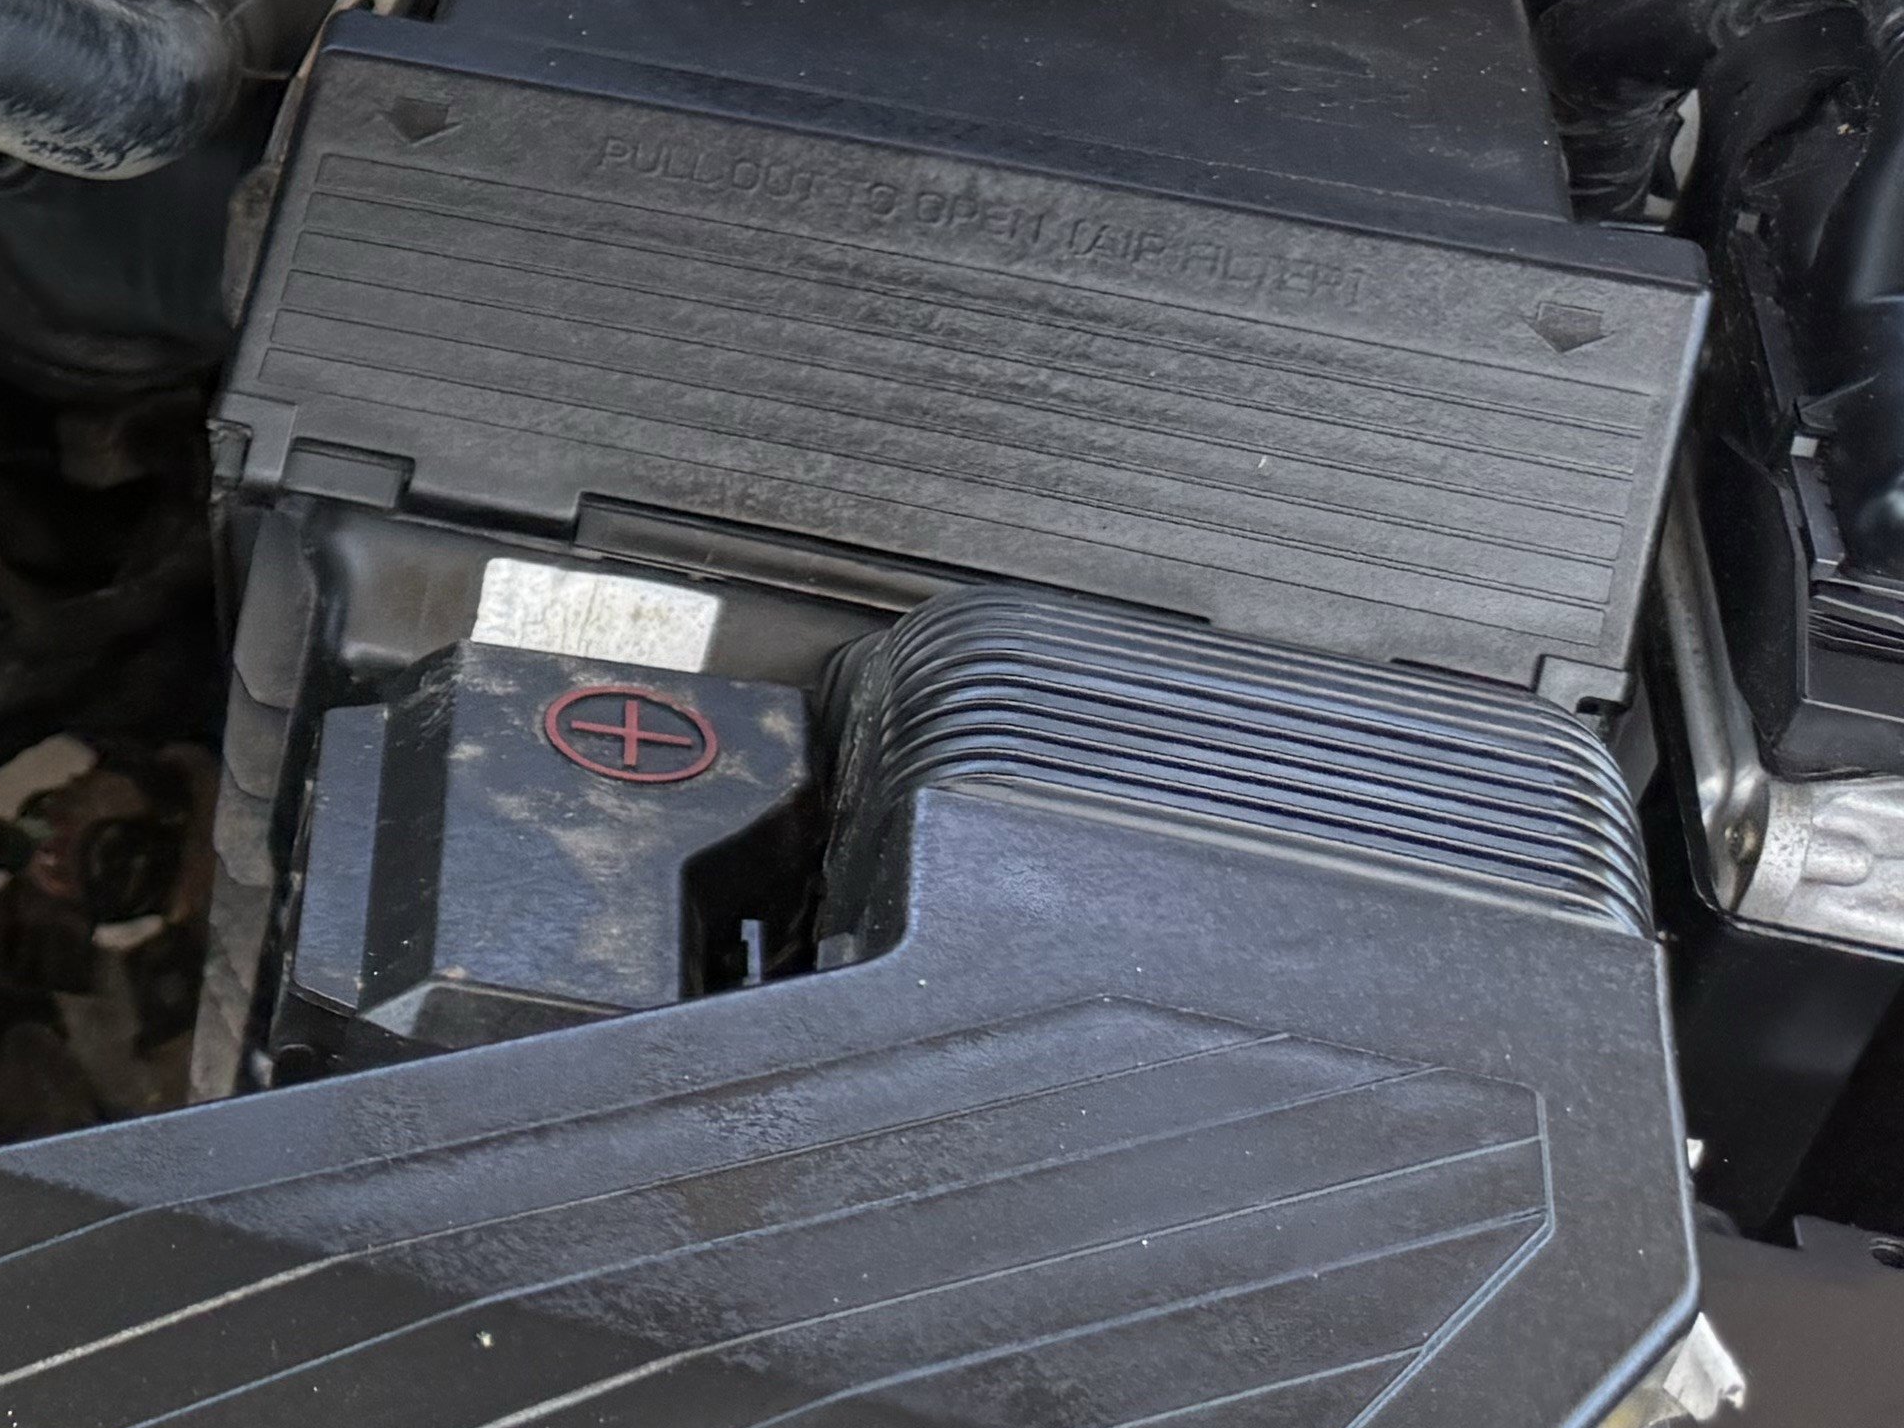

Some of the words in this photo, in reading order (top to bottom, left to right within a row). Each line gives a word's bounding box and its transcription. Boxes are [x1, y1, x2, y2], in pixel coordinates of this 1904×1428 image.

[597, 135, 722, 184] PULL
[731, 156, 815, 202] OUT
[916, 190, 1044, 244] OPEN
